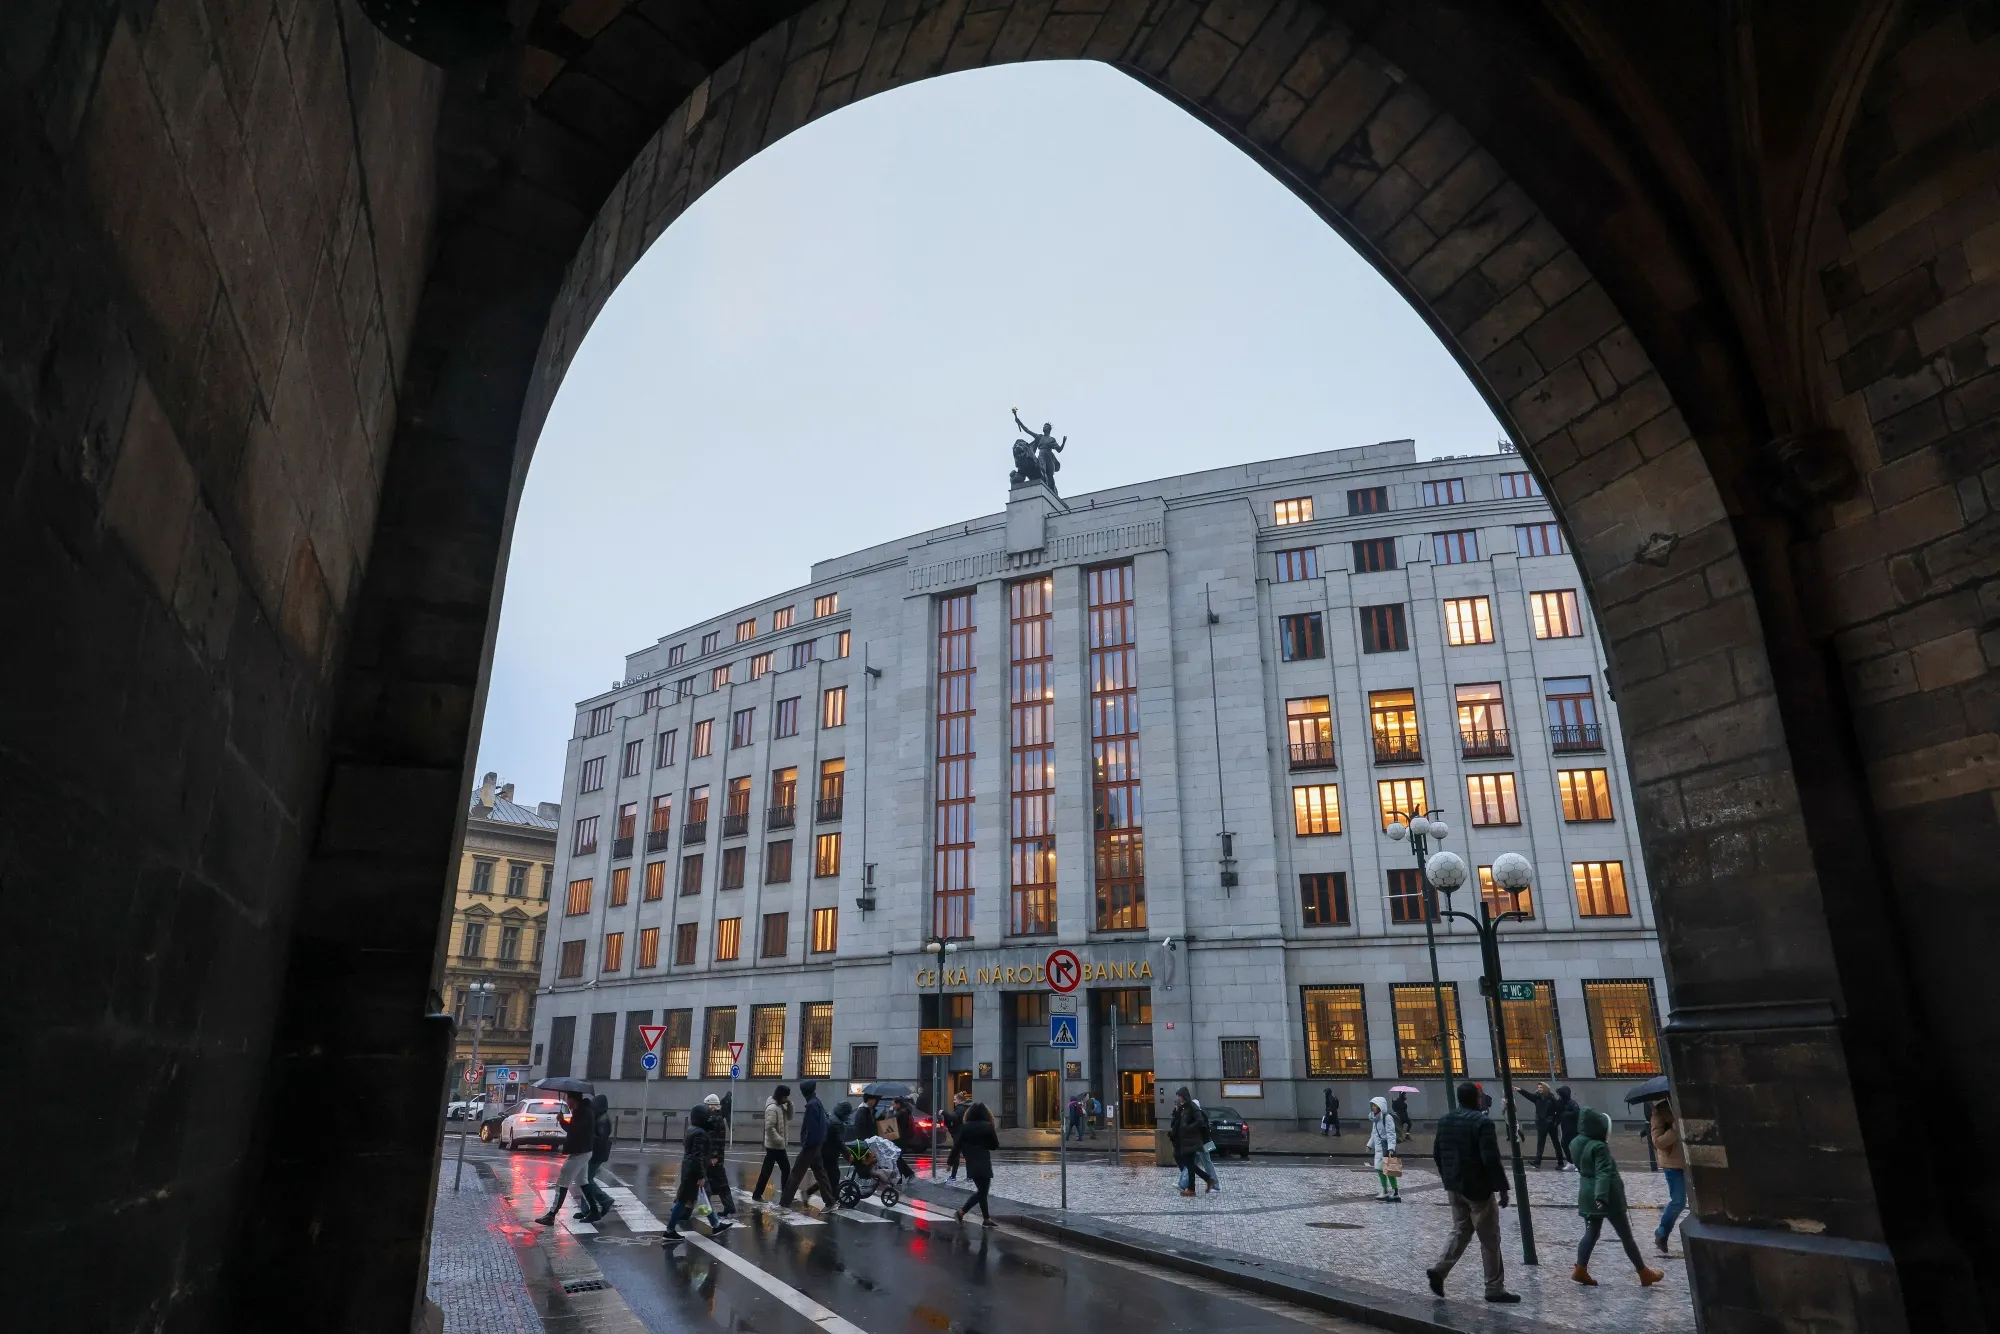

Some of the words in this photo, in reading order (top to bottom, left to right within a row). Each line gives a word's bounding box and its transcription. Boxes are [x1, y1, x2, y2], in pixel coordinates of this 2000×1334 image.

[977, 964, 1046, 985] NÁROD
[1083, 960, 1153, 981] BANKA
[1510, 985, 1522, 997] WC
